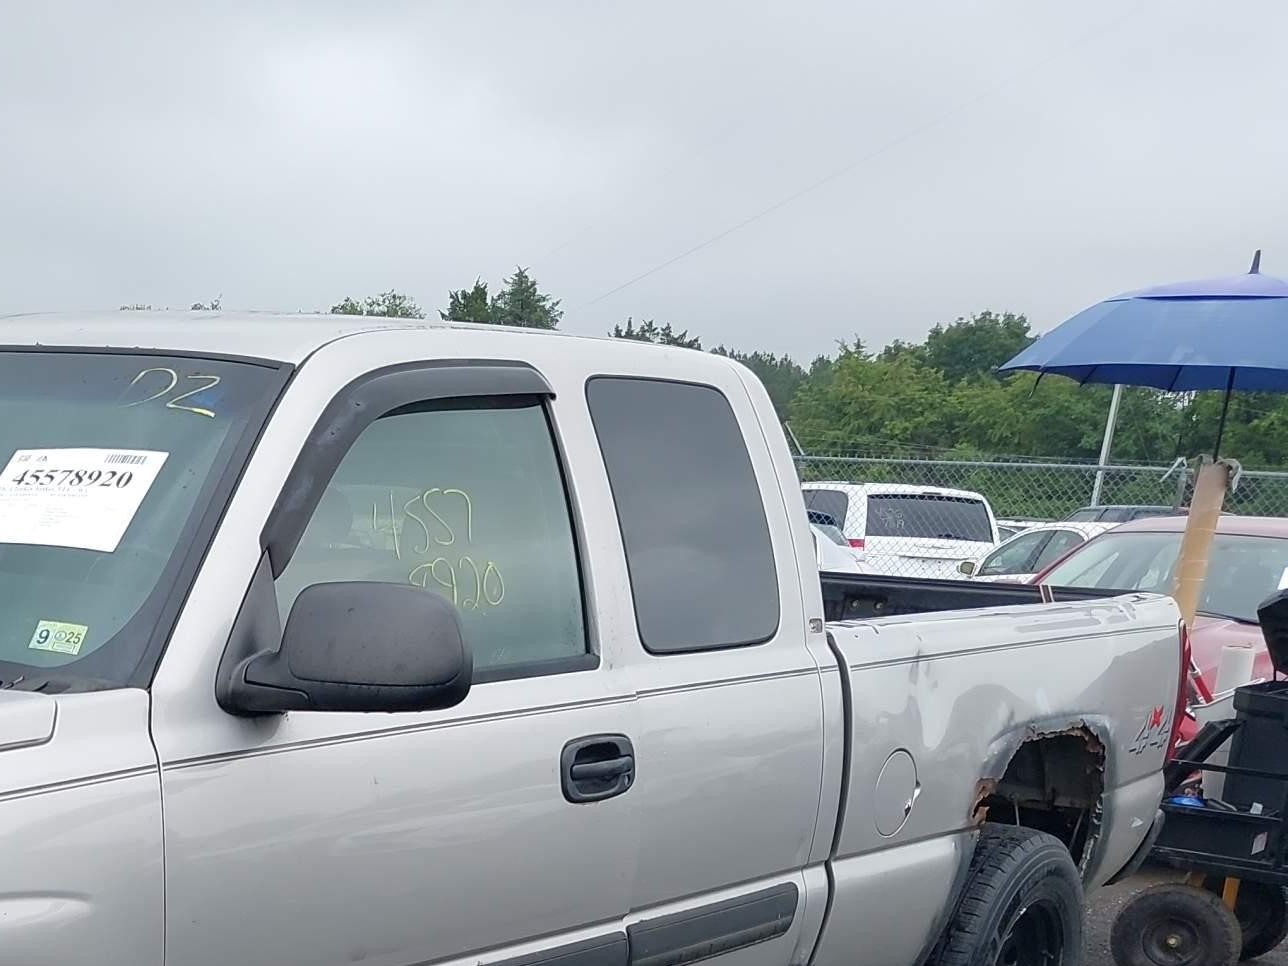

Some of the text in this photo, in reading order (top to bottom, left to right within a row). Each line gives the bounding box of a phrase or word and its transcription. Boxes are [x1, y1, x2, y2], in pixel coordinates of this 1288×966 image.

[12, 469, 133, 488] 45578920
[36, 628, 82, 644] 9 25
